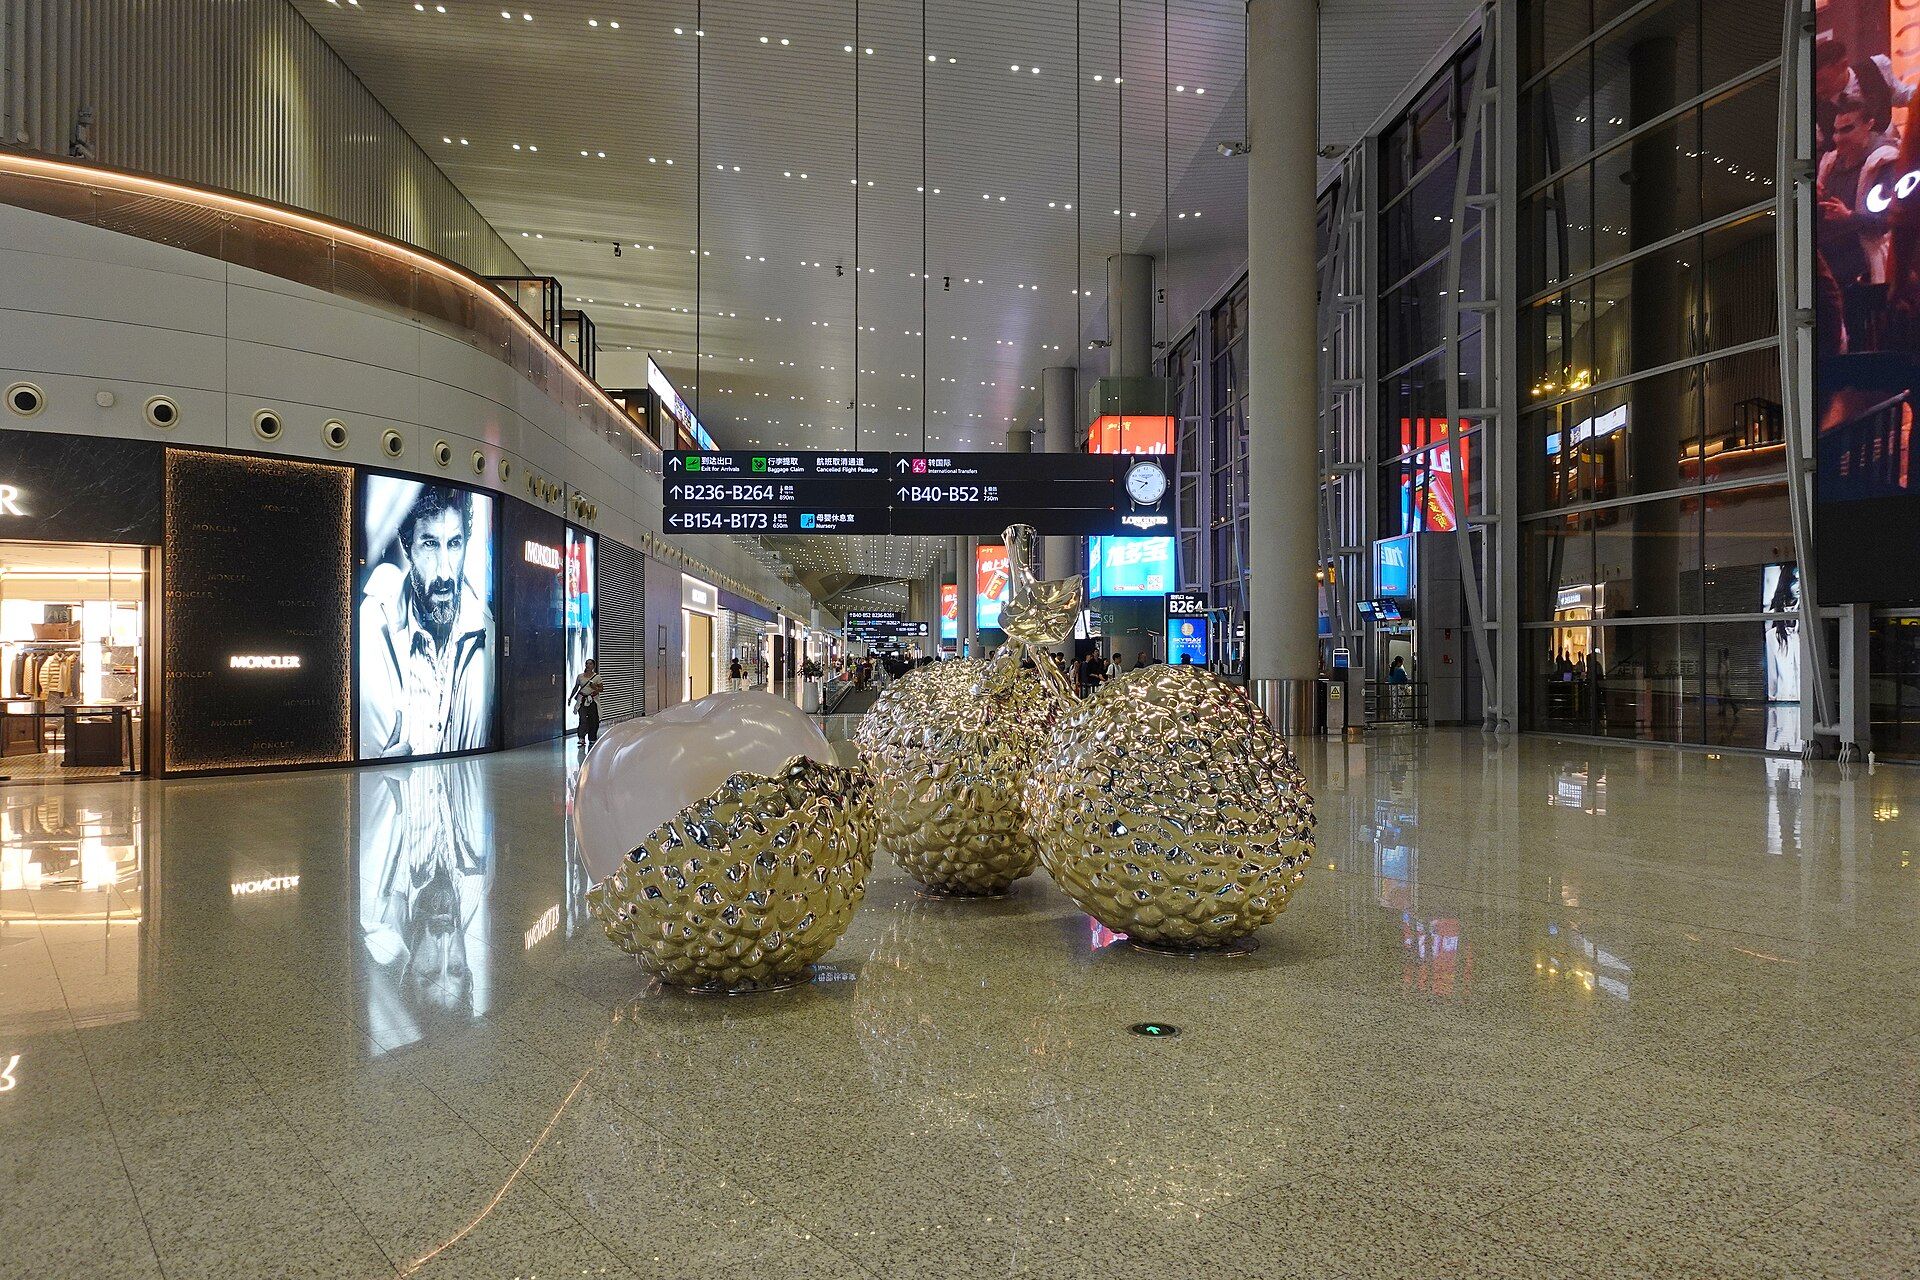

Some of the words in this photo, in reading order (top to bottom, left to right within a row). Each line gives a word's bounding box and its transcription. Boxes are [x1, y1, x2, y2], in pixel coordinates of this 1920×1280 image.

[701, 456, 733, 466] 到达出口
[767, 457, 799, 466] 行李提取
[816, 457, 864, 466] 航班取消通道
[928, 459, 952, 467] 转国际
[684, 485, 774, 500] B236-B264
[911, 486, 979, 502] B40-B52
[684, 513, 768, 528] B154-B173
[816, 514, 855, 522] 母婴休息室
[1169, 600, 1204, 613] B264
[229, 655, 300, 669] MONCLER
